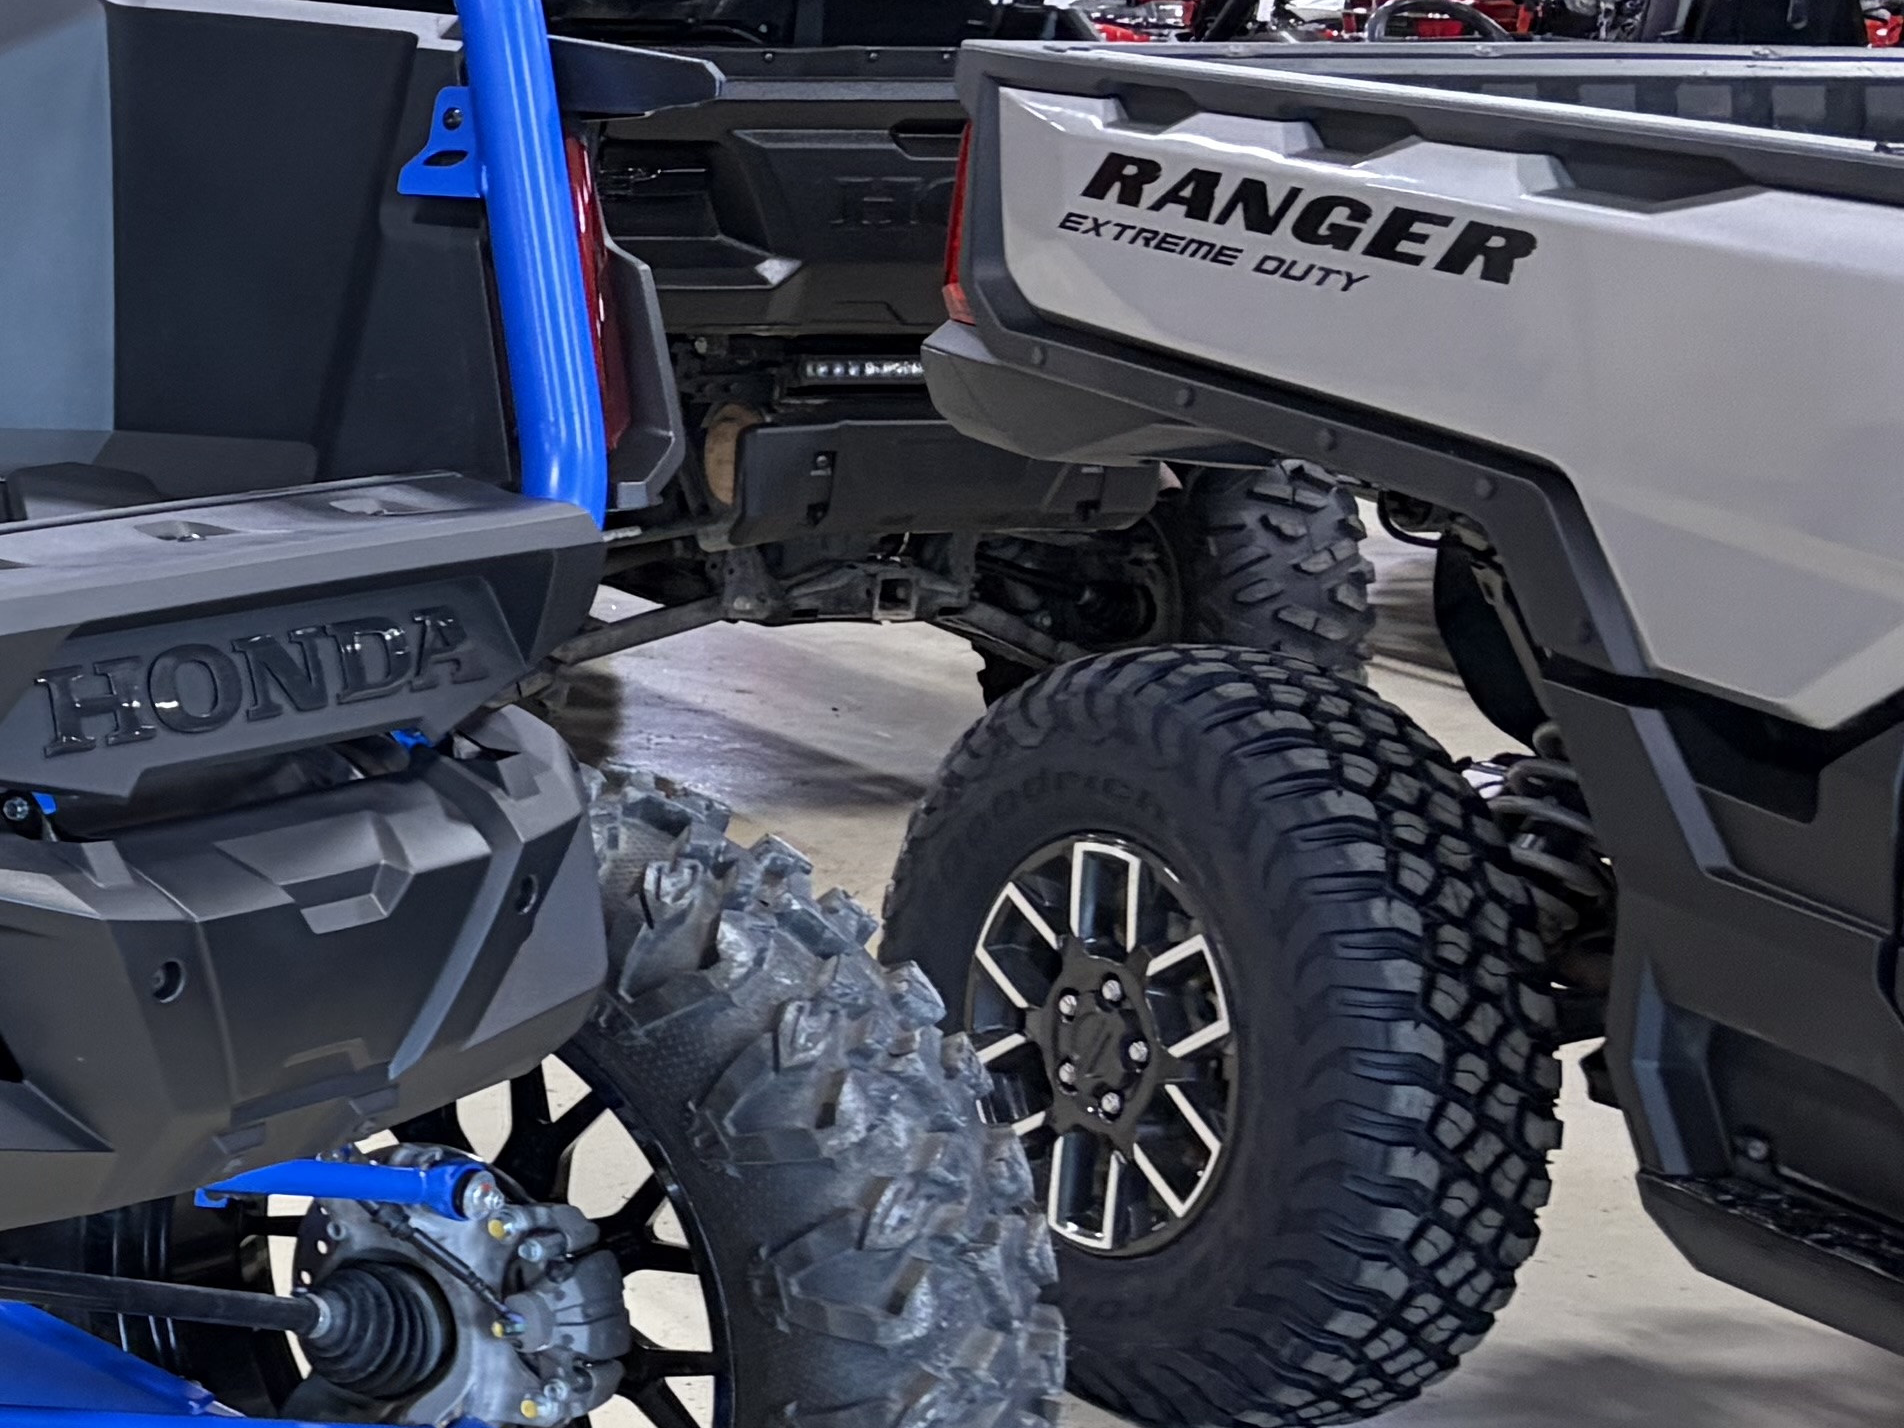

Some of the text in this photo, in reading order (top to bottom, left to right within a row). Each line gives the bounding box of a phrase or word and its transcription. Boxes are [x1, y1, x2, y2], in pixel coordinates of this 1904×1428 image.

[1058, 212, 1371, 293] EXTREME DUTY
[1080, 151, 1538, 285] RANGER
[33, 604, 488, 759] HONDA
